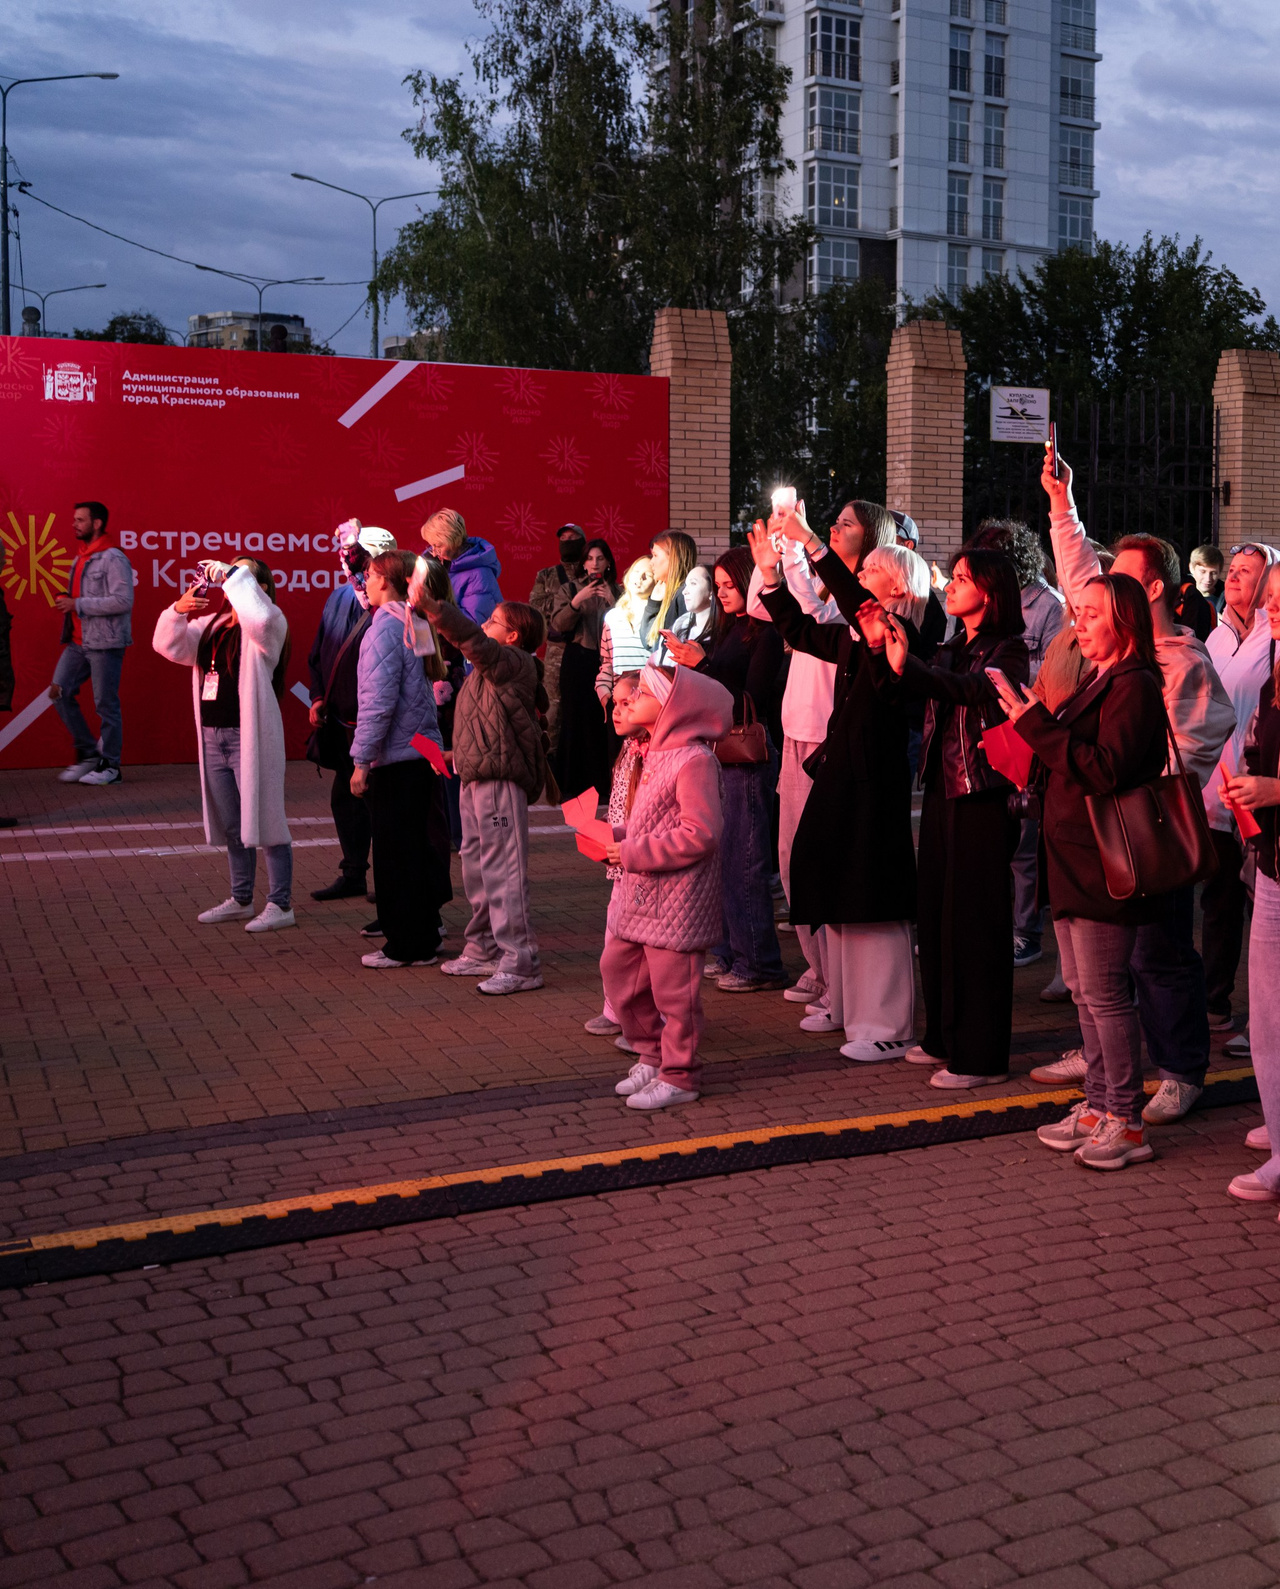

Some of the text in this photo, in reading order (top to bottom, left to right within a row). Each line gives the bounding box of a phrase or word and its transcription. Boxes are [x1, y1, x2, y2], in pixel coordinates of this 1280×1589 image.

[122, 370, 219, 385] Администрация
[0, 383, 34, 391] асно
[122, 383, 300, 399] муниципального образования
[122, 395, 226, 408] город Краснодар
[462, 475, 494, 484] расно
[635, 479, 668, 489] Красн
[120, 530, 341, 557] встречаемся
[152, 559, 351, 594] Кродар
